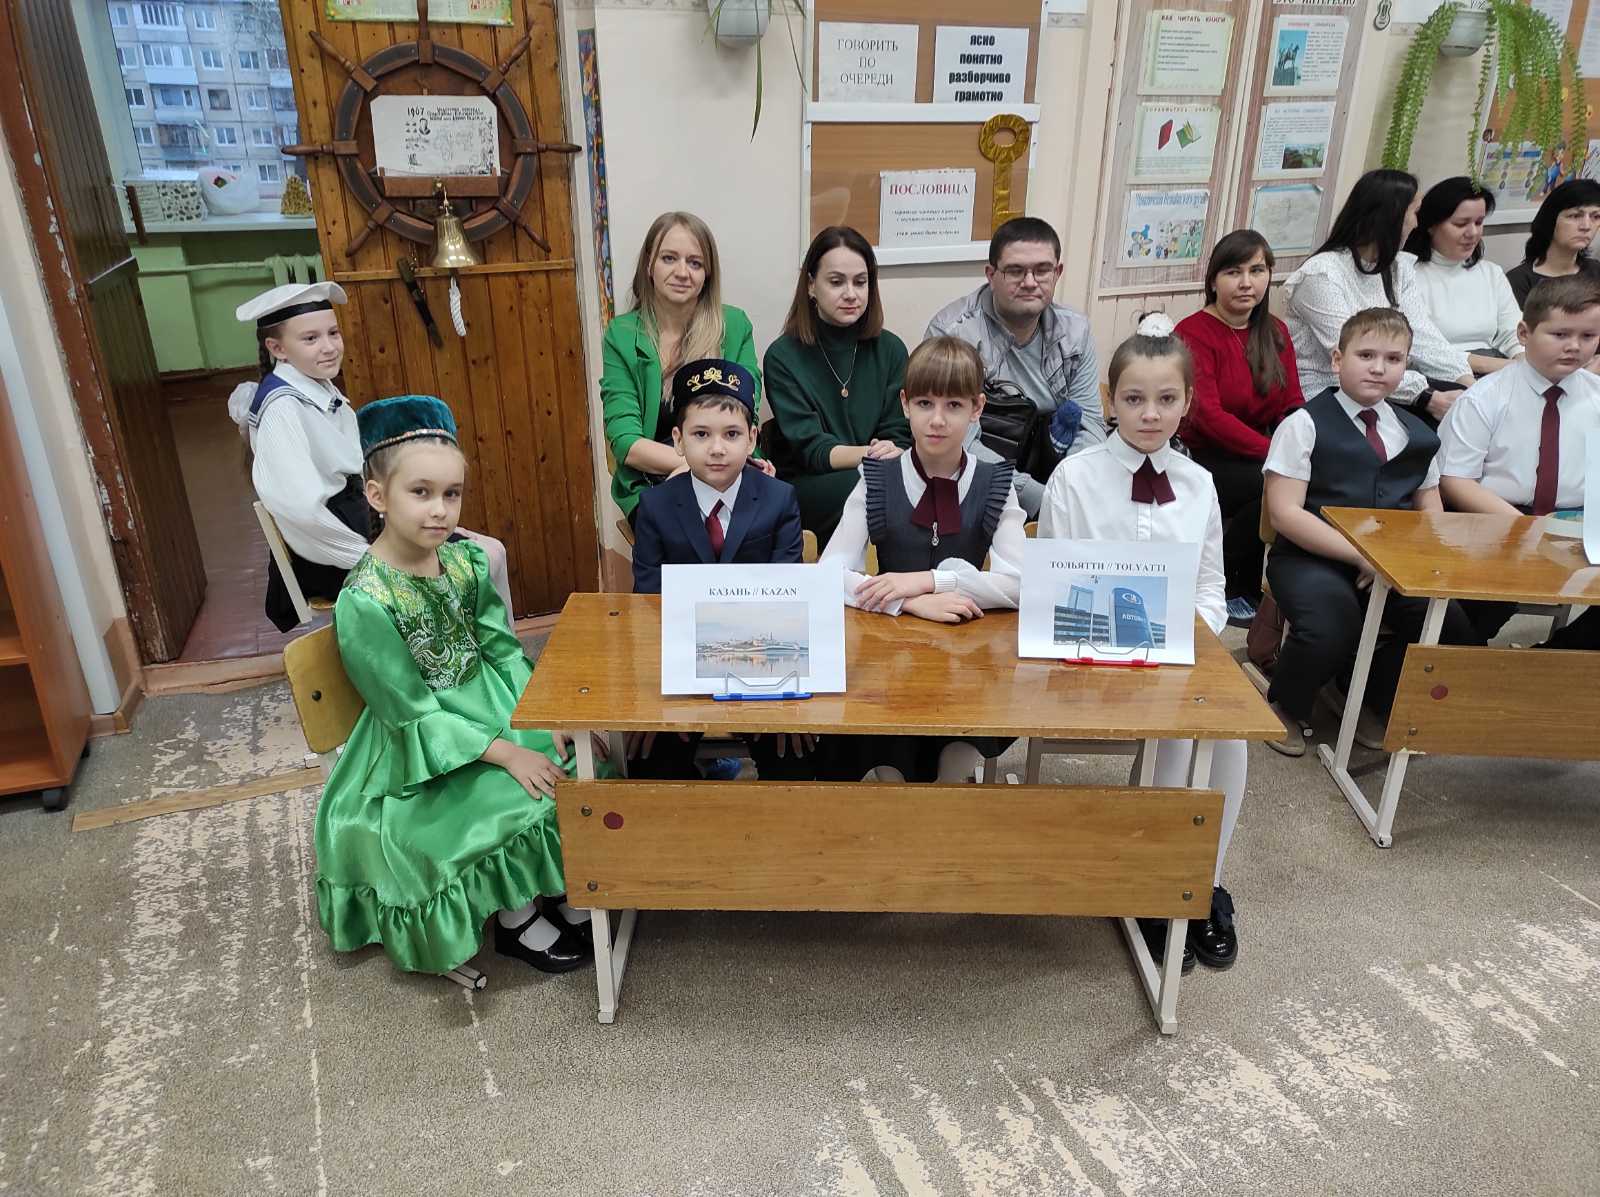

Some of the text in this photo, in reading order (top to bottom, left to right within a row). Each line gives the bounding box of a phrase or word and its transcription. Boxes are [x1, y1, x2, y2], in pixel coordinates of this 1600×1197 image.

[837, 38, 899, 52] ГОВОРИТЬ
[970, 34, 996, 47] ЯСНО
[858, 56, 876, 69] ПО
[959, 53, 1003, 65] понятно
[840, 72, 894, 87] ОЧЕРЕДИ
[948, 70, 1011, 85] разборчиво
[954, 90, 1004, 103] грамотно
[889, 183, 969, 196] ПОСЛОВИЦА
[1050, 560, 1105, 571] ТОЛЬЯТТИ
[1115, 562, 1168, 573] TOLYATTI
[709, 587, 751, 597] КАЗАНЬ
[761, 587, 798, 596] KAZAN
